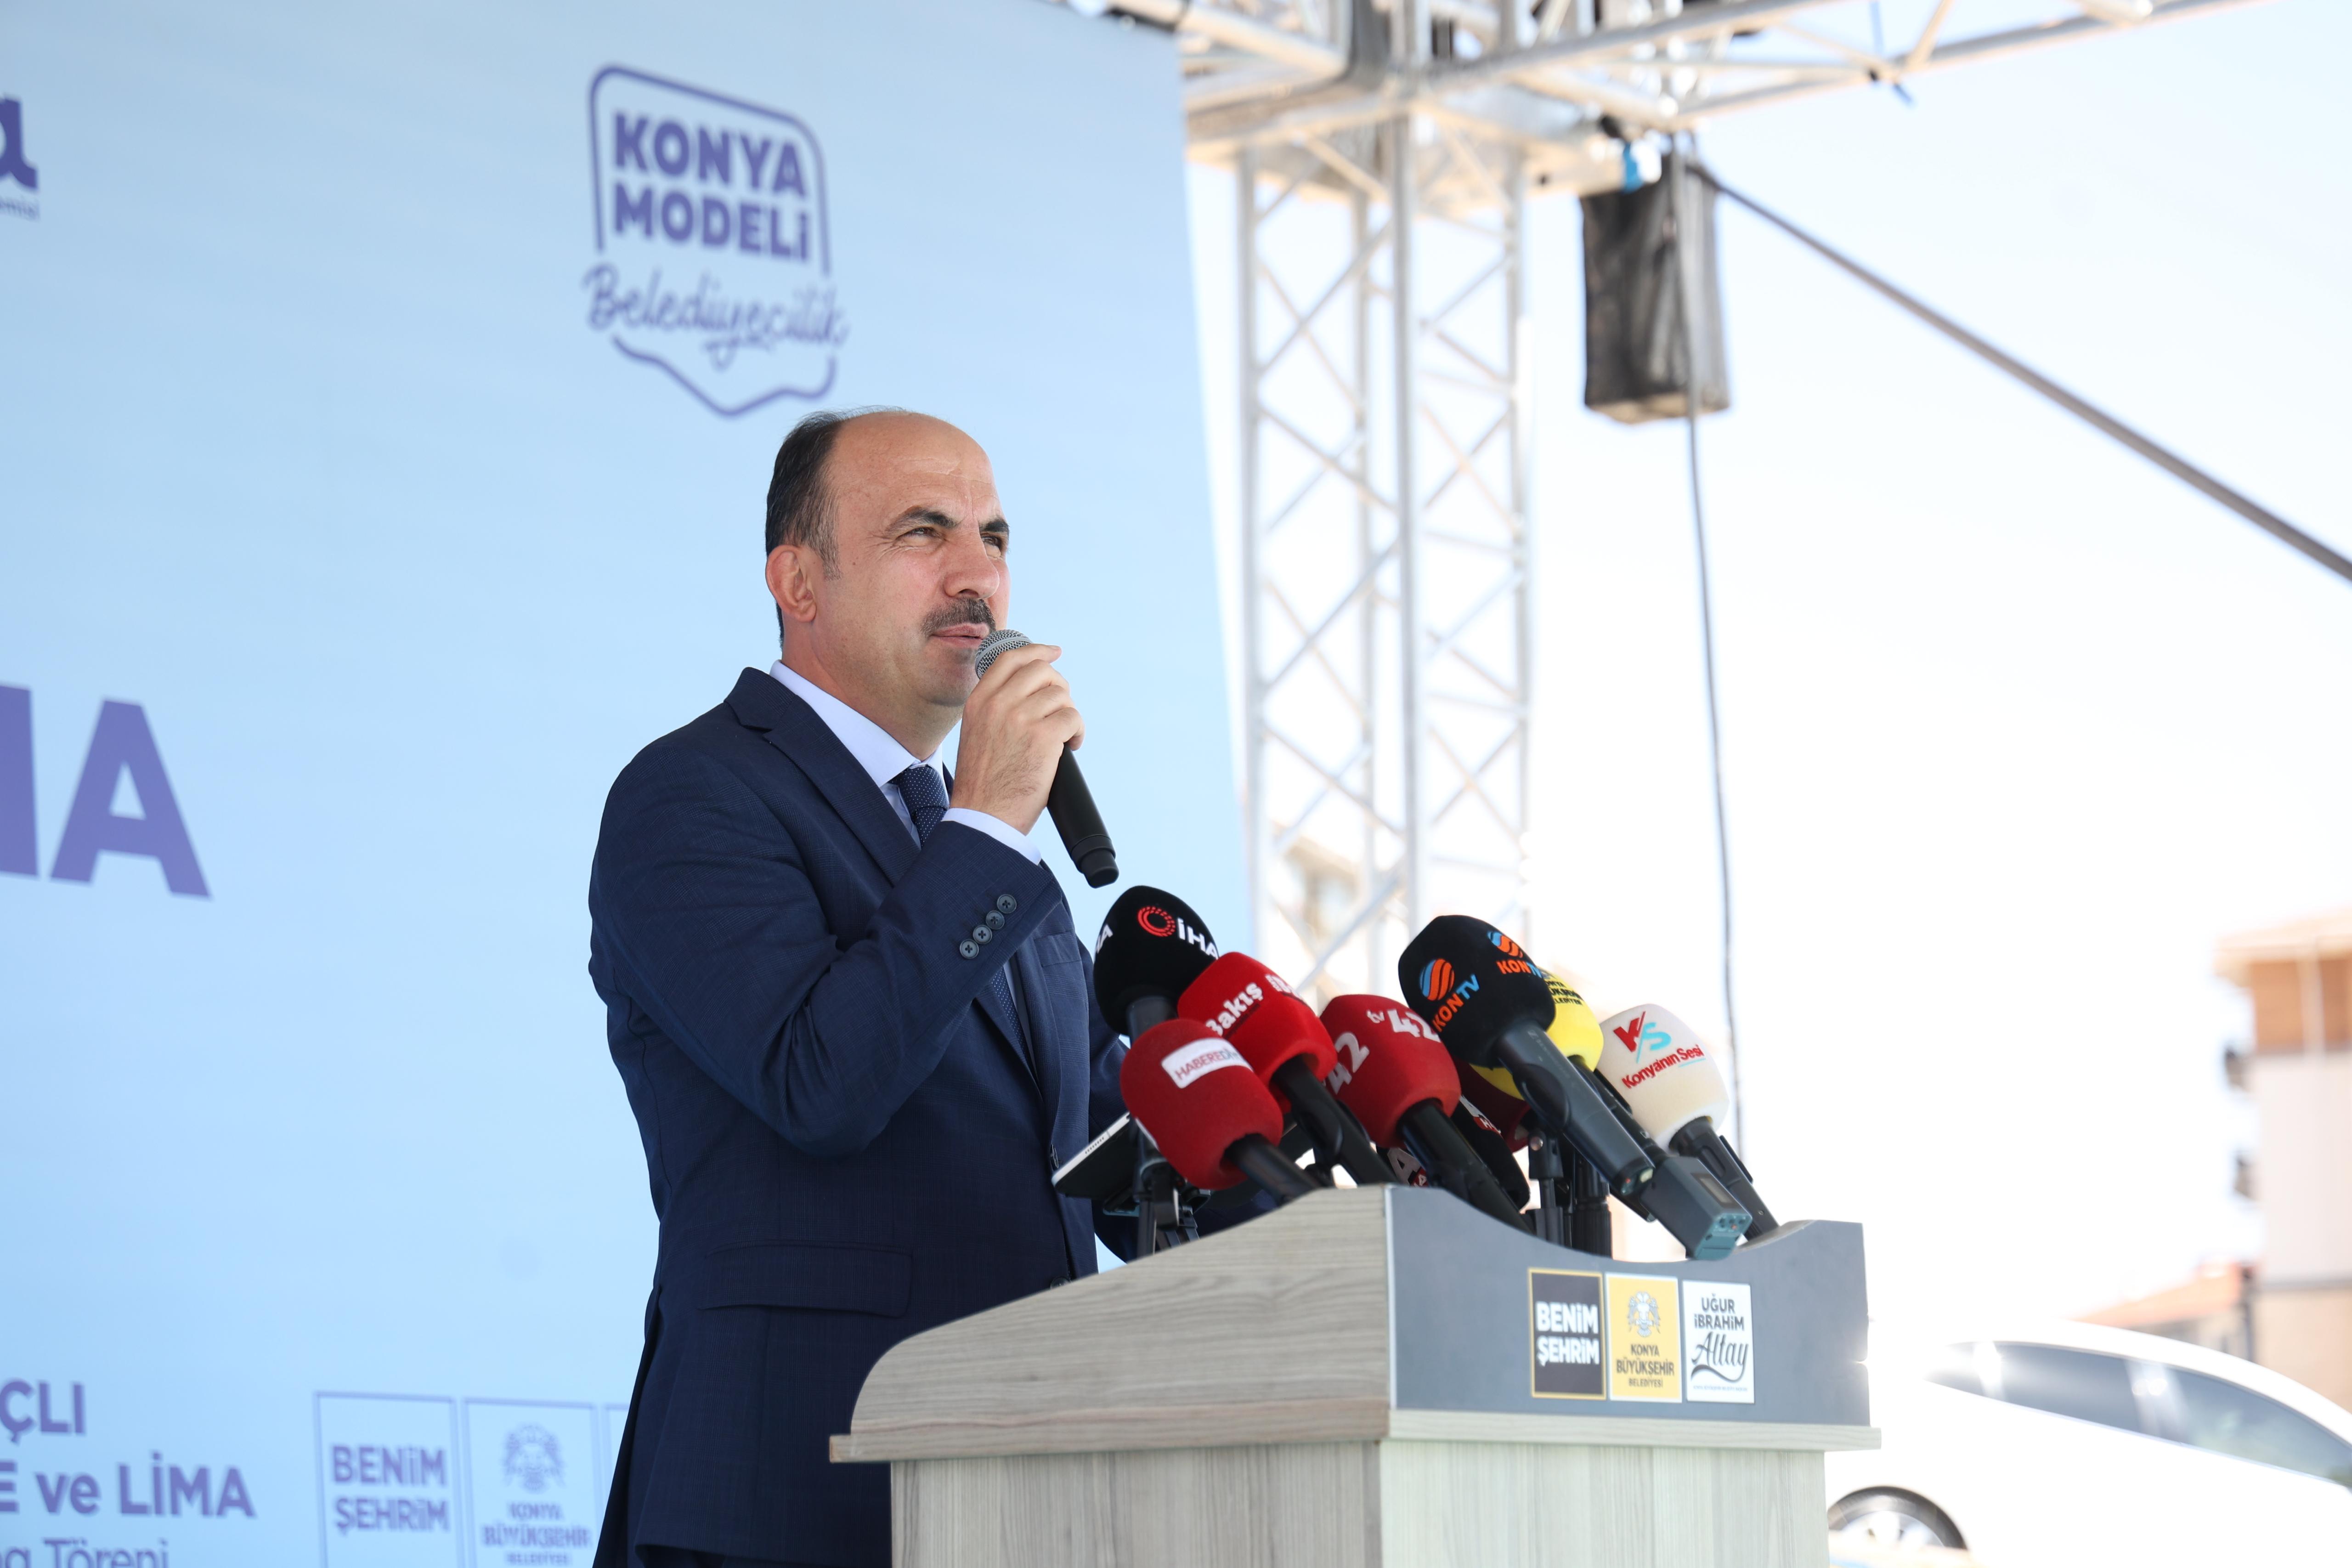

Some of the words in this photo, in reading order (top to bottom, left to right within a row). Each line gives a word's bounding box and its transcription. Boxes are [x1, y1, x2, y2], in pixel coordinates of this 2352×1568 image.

[615, 113, 807, 197] KONYA
[615, 183, 808, 261] MODELİ
[583, 264, 848, 370] Belediyecilik
[1177, 917, 1219, 960] İHA
[1432, 974, 1480, 1033] KONTV
[1676, 1044, 1705, 1061] Sesi
[1536, 1300, 1599, 1334] BENİM
[1701, 1293, 1736, 1313] UĞUR
[1694, 1314, 1745, 1331] İBRAHİM
[1537, 1335, 1600, 1366] ŞEHRİM
[1616, 1356, 1675, 1376] BÜYÜKŞEHİR
[1631, 1343, 1660, 1356] KONYA
[1691, 1331, 1749, 1382] Altay
[1628, 1376, 1663, 1388] BELEDİYESİ
[35, 1472, 100, 1515] ve
[119, 1451, 256, 1517] LİMA
[330, 1445, 447, 1487] BENİM
[334, 1498, 450, 1535] ŞEHRİM
